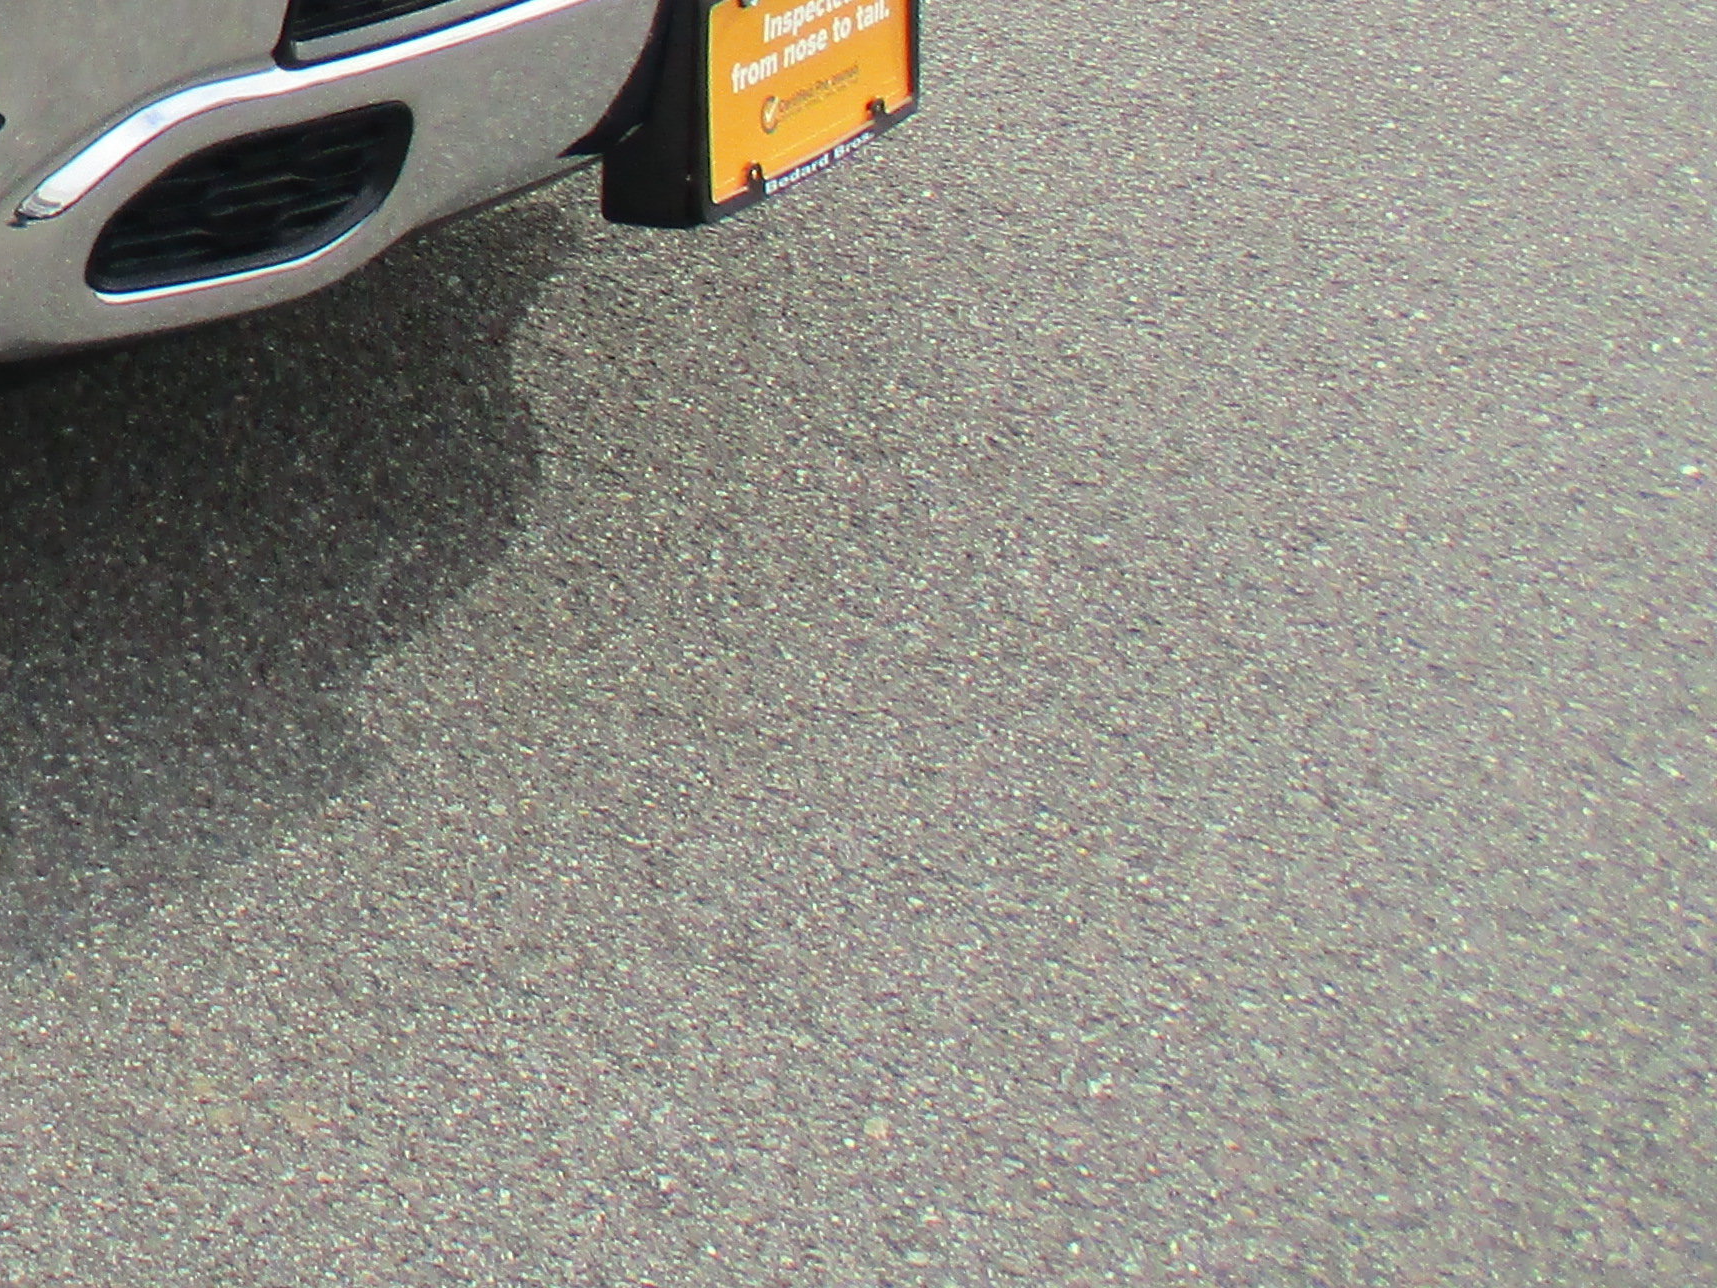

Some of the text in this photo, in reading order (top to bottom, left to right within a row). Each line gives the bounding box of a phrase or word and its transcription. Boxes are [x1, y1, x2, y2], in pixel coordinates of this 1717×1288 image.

[731, 52, 778, 94] from
[783, 28, 829, 68] nose
[832, 16, 852, 43] to
